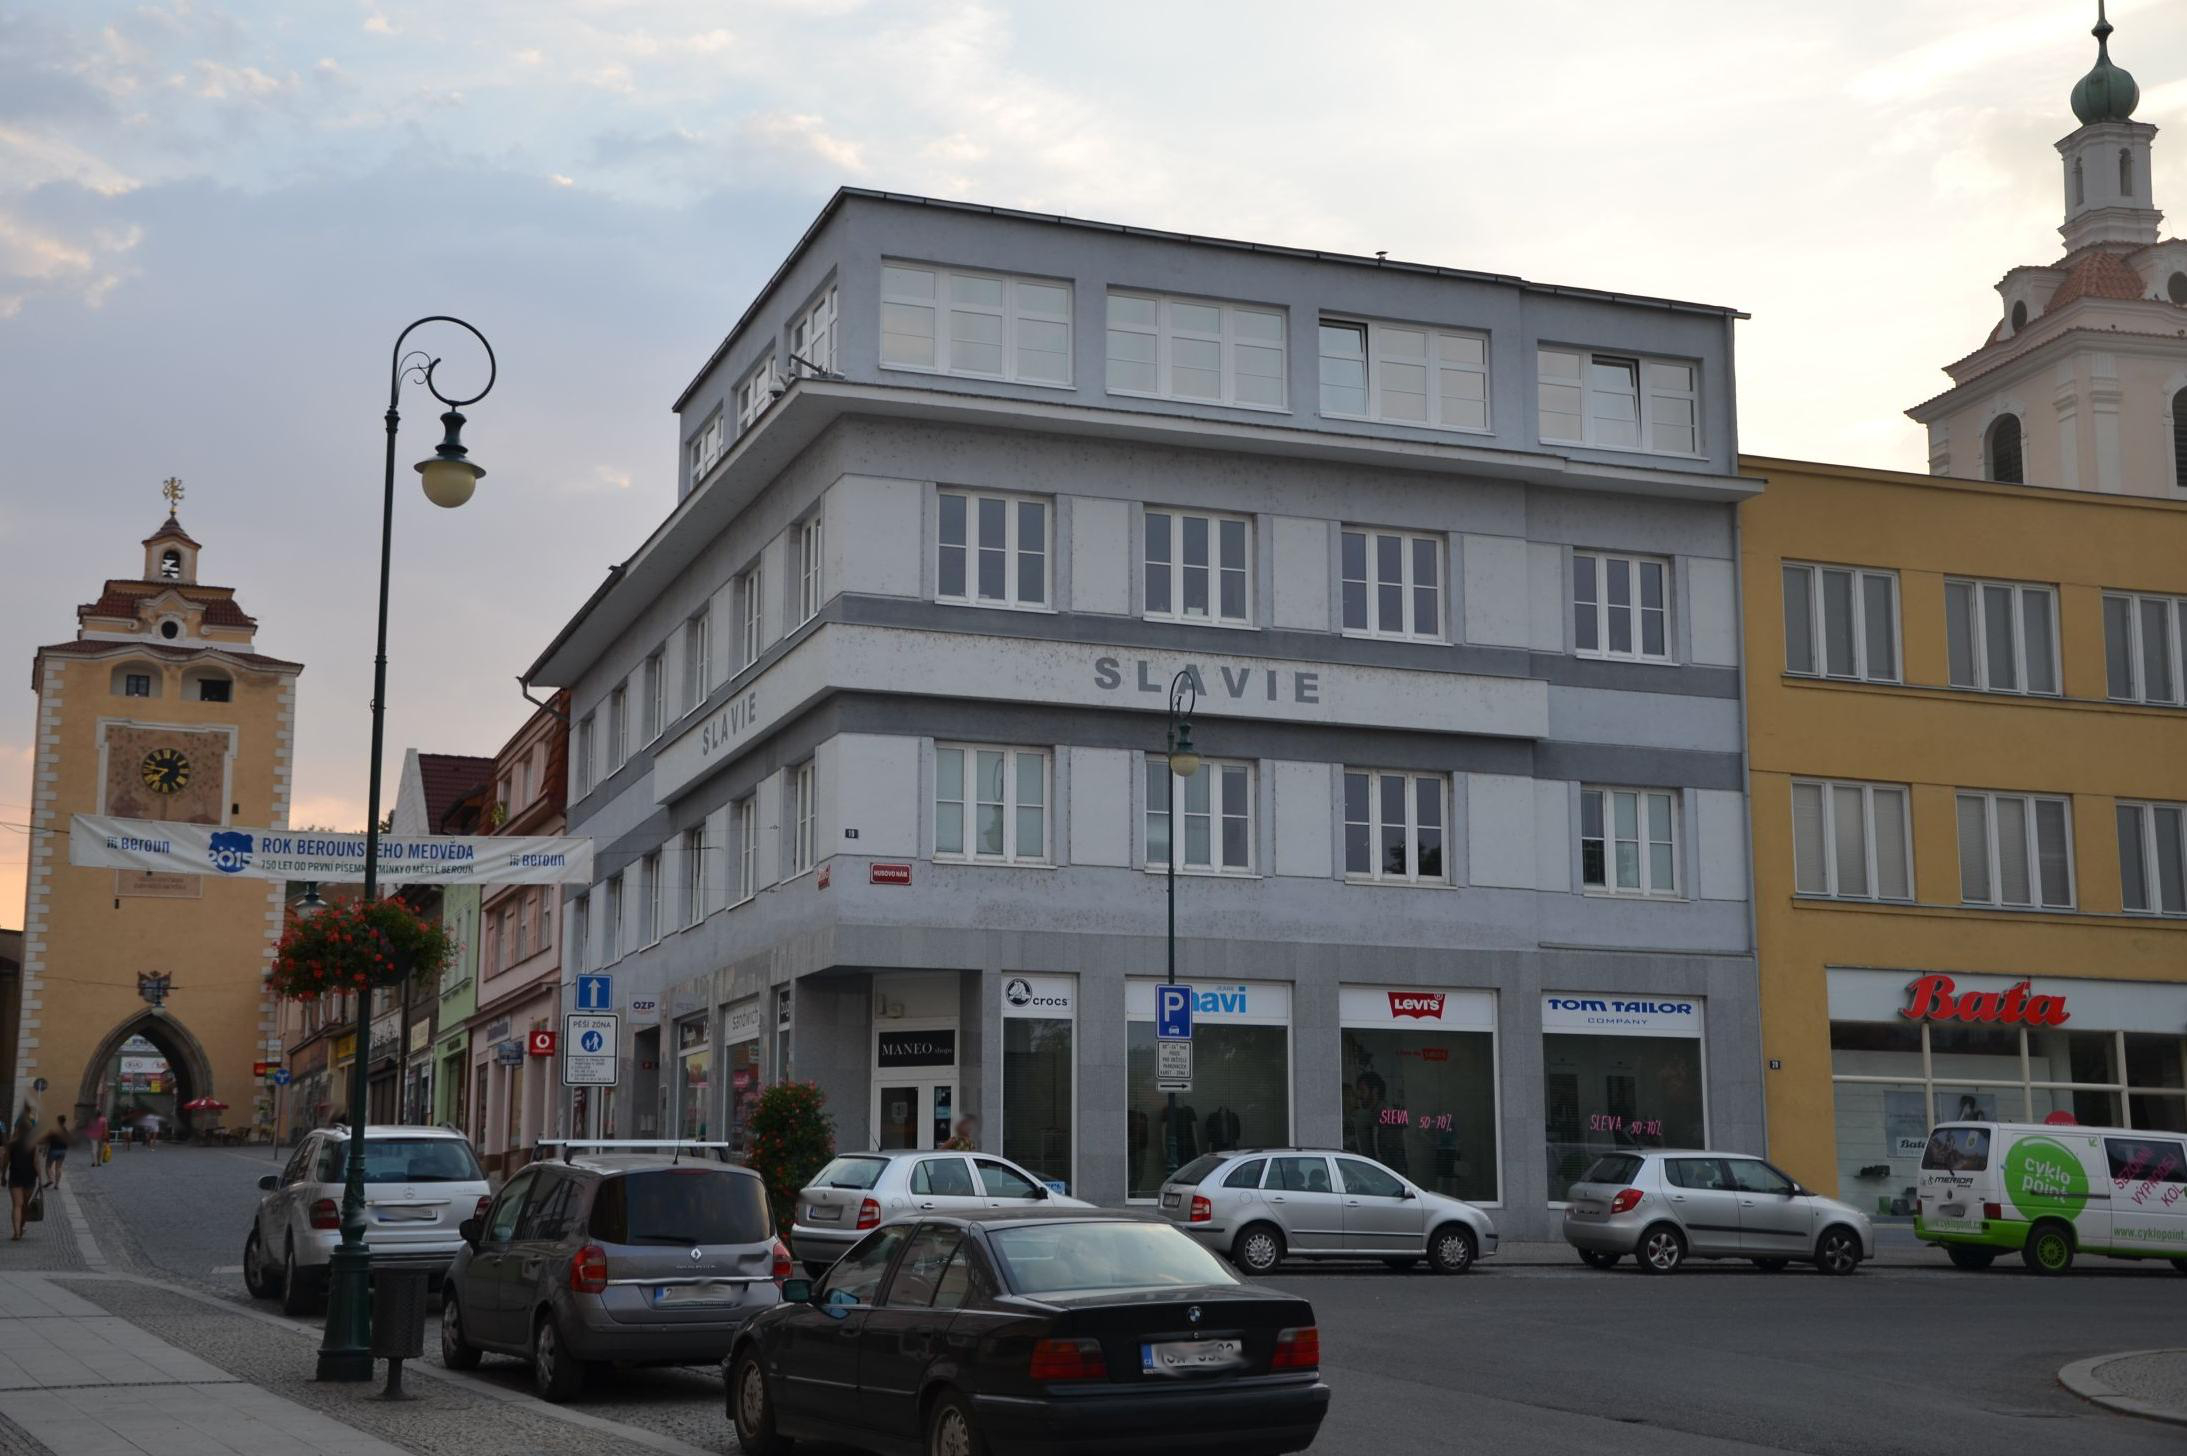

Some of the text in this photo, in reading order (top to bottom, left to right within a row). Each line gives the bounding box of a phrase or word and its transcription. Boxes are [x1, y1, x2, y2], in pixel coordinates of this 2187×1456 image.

[1094, 656, 1319, 704] SLAVIE
[703, 691, 756, 756] SLAVIE
[262, 836, 475, 860] ROK BEROUNSÉHO MEDVĚDA
[278, 861, 293, 870] LET
[294, 861, 306, 871] OD
[307, 860, 333, 873] PRVNÍ
[441, 864, 474, 874] BEROUN
[873, 870, 896, 878] HUSOVO
[633, 1001, 655, 1010] OZP
[1032, 997, 1068, 1006] crocs
[1164, 991, 1184, 1022] P
[1548, 999, 1692, 1015] TOM TAILOR
[1587, 1017, 1649, 1025] COMPANY
[882, 1042, 933, 1056] MANEO
[1379, 1107, 1409, 1125] SLEVA
[1590, 1113, 1622, 1131] SLEVA
[2025, 1157, 2071, 1186] cyklo
[1934, 1176, 1974, 1185] MERIDA
